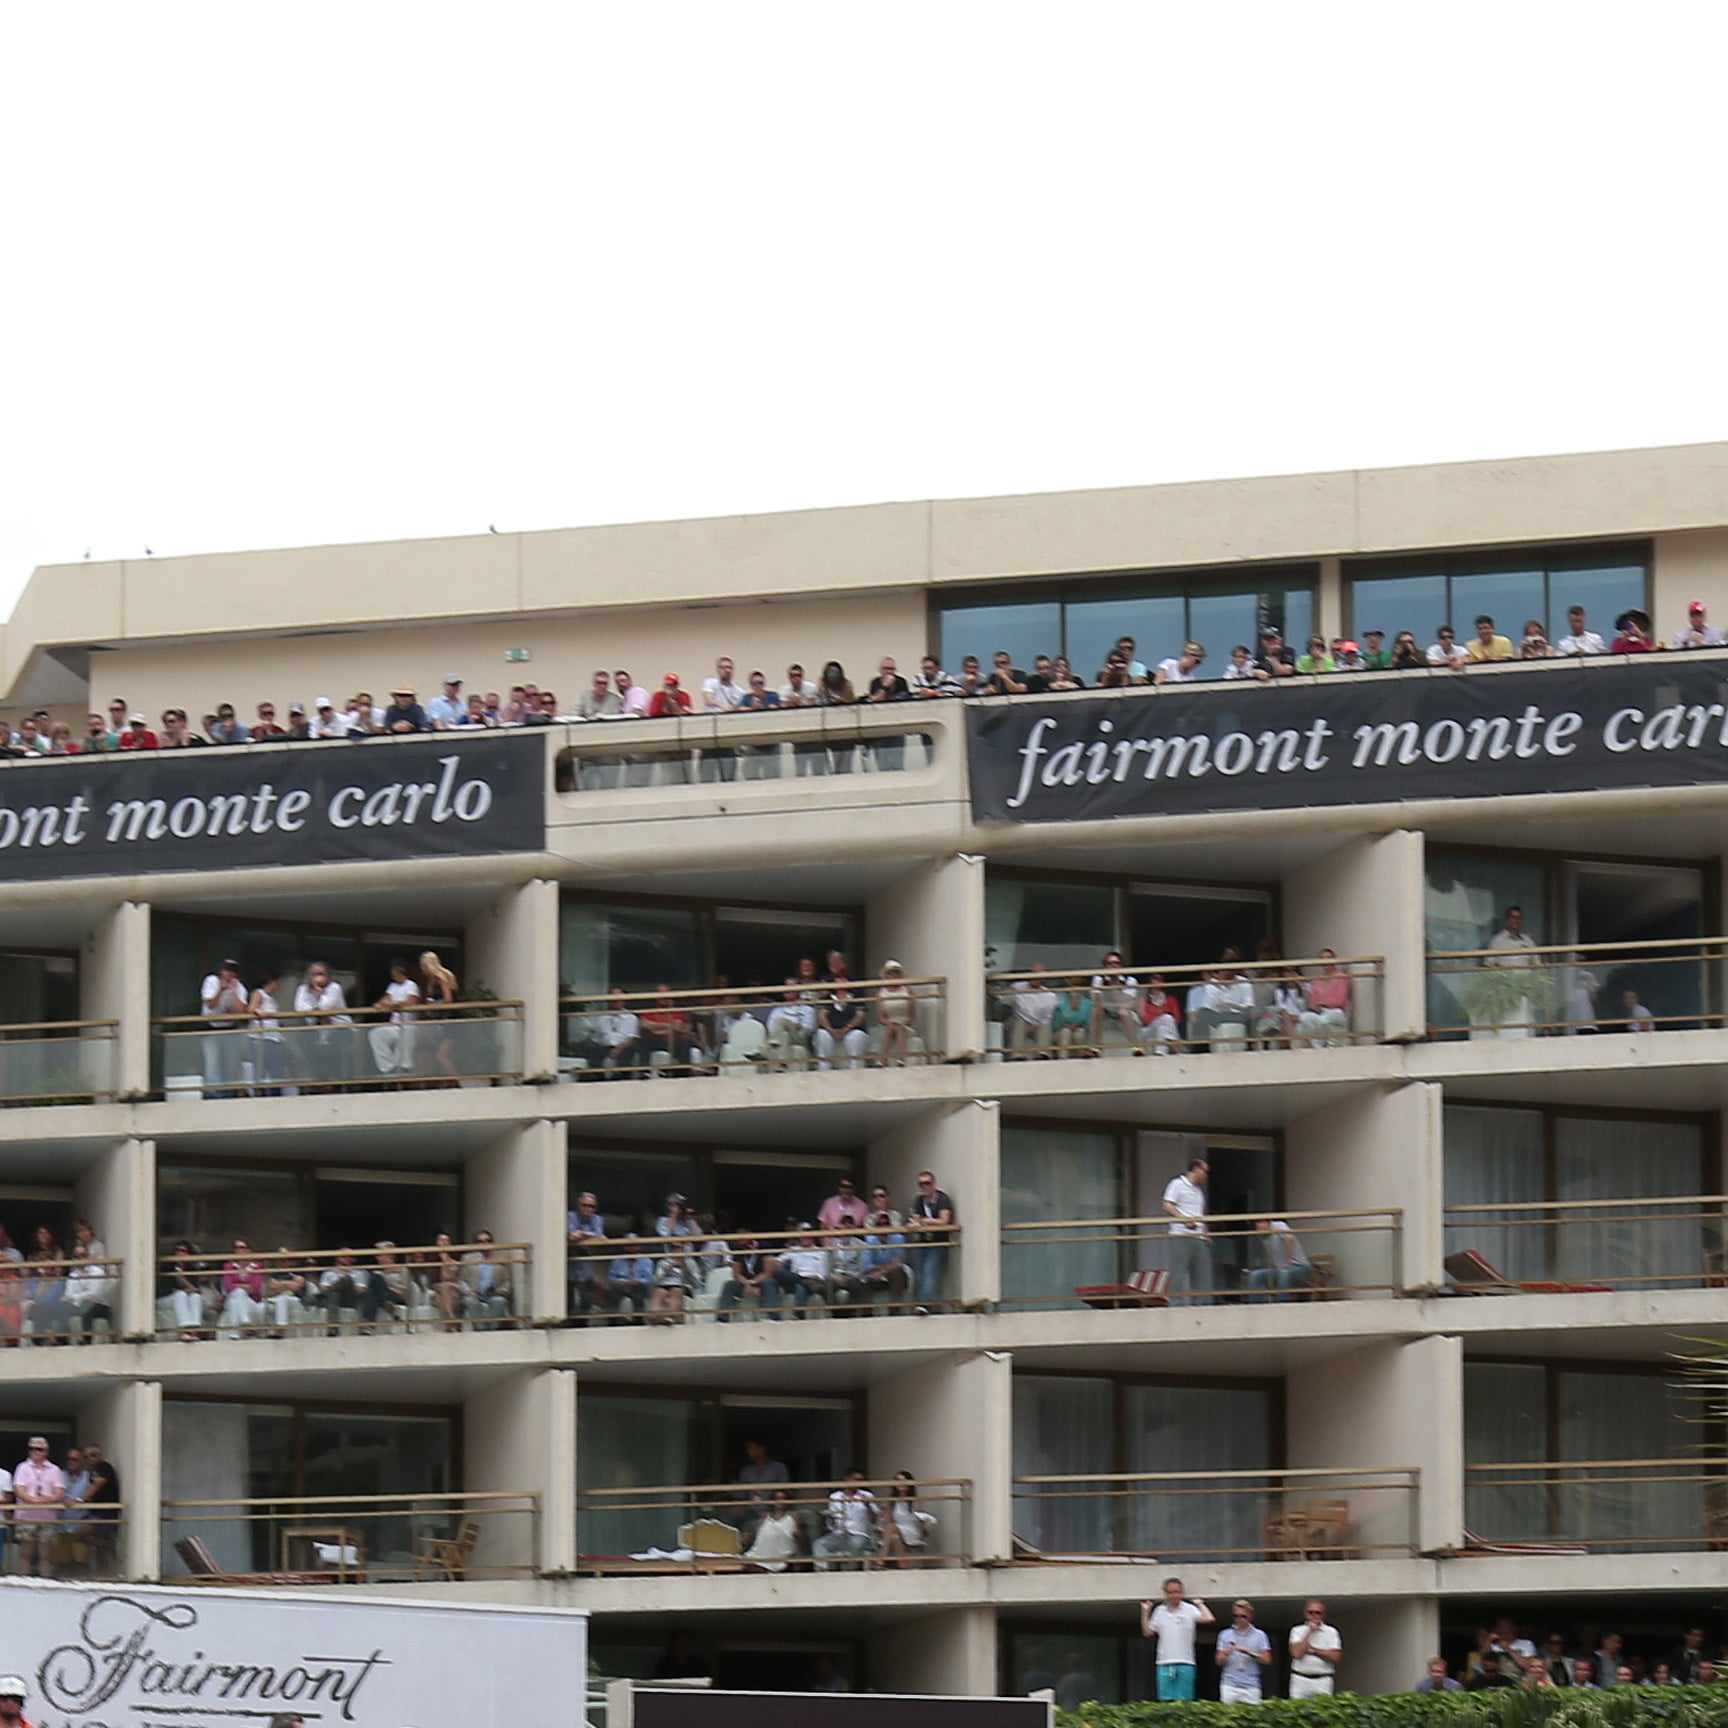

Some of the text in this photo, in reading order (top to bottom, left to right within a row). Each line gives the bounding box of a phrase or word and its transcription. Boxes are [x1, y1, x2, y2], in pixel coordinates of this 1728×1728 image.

[105, 784, 312, 842] monte
[327, 755, 494, 829] carlo
[1005, 717, 1334, 809] fairmont
[1352, 704, 1583, 768] monte
[35, 1595, 393, 1721] Fairmont
